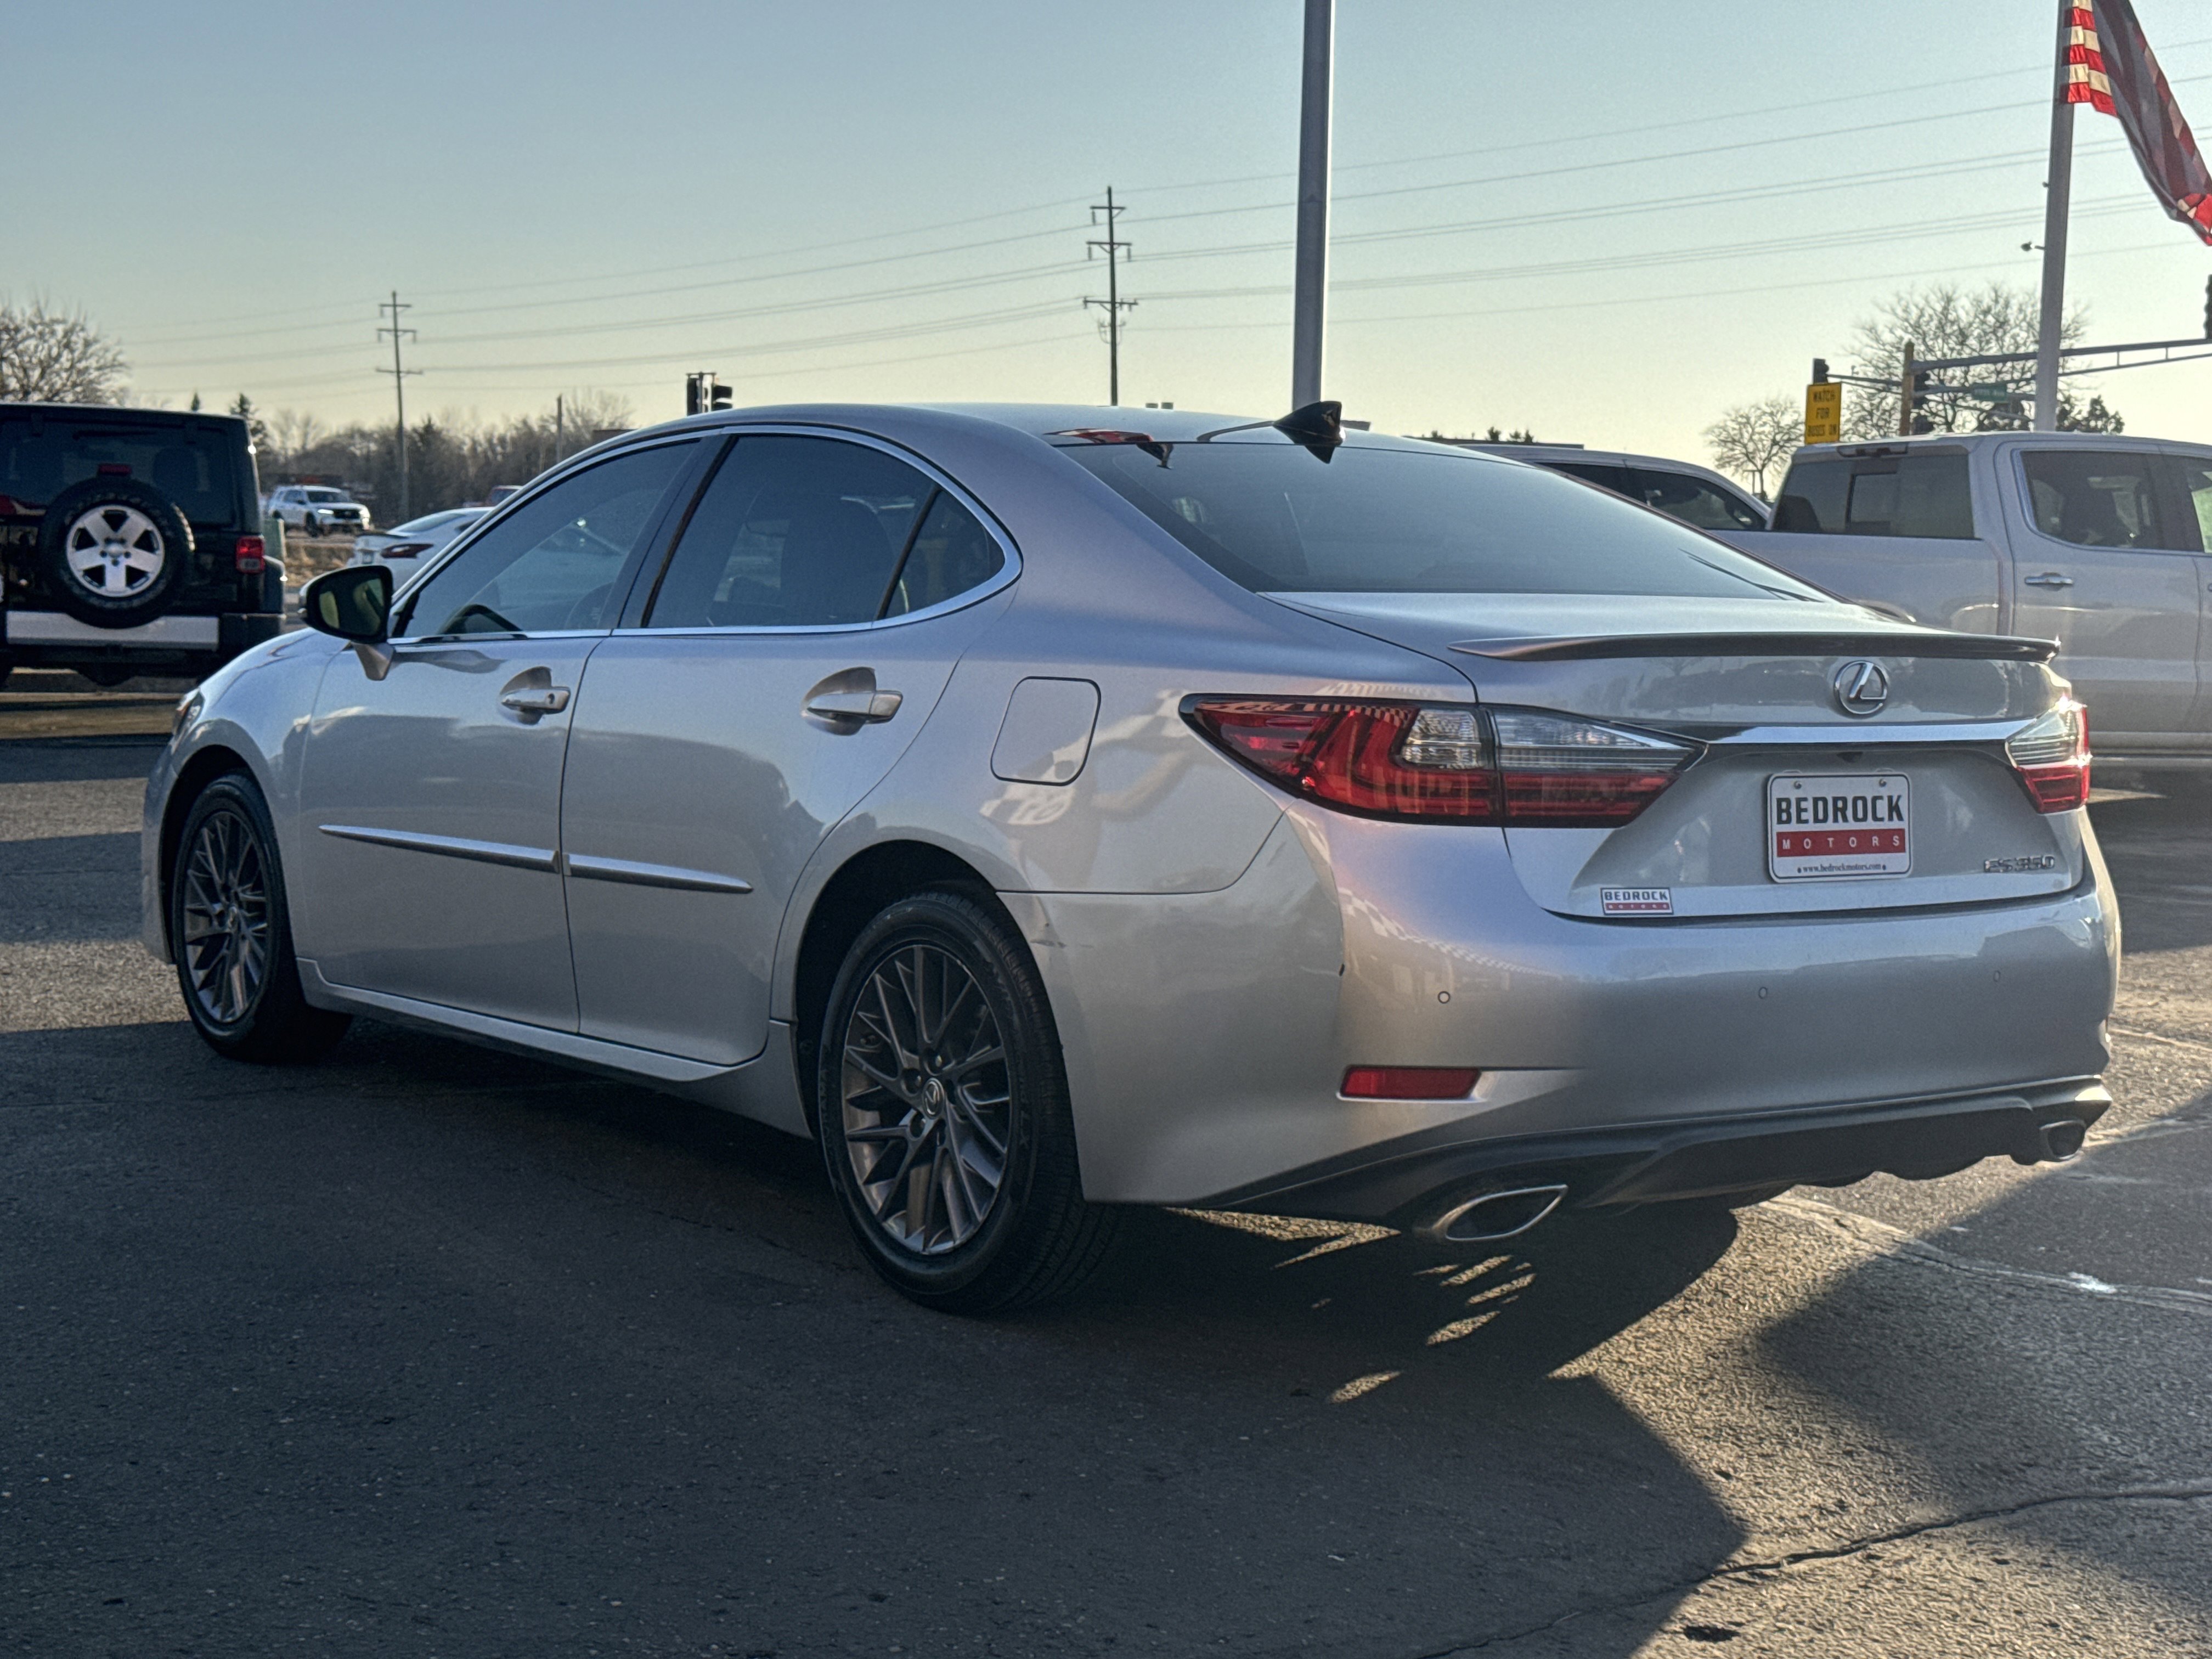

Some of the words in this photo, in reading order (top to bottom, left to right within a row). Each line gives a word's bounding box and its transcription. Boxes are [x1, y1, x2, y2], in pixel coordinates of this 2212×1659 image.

[1813, 388, 1836, 403] WATCH
[1816, 407, 1830, 419] FOR
[1776, 794, 1904, 825] BEDROCK
[1782, 835, 1900, 850] MOTORS
[1802, 863, 1882, 872] www.bedrockmotors.com
[1984, 859, 2013, 872] ES
[2015, 854, 2055, 872] 350
[1605, 891, 1668, 901] BEDROCK
